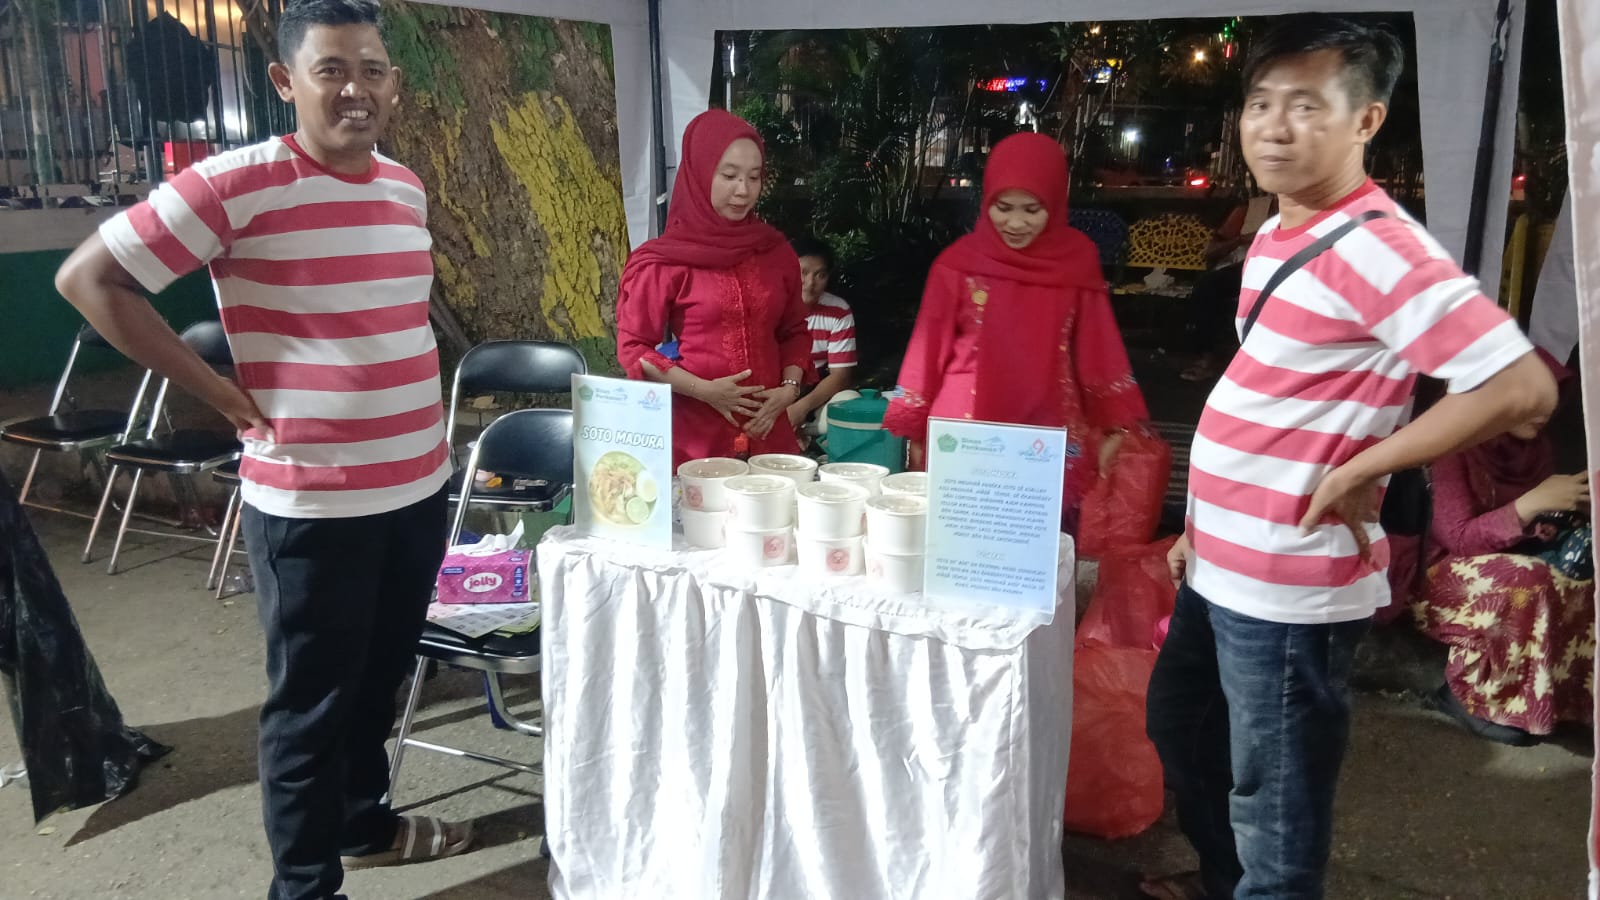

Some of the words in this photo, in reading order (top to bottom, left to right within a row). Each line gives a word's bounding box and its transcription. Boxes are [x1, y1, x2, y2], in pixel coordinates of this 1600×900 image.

[582, 425, 612, 443] SOTO
[615, 430, 664, 449] MADURA
[469, 576, 497, 589] jolly
